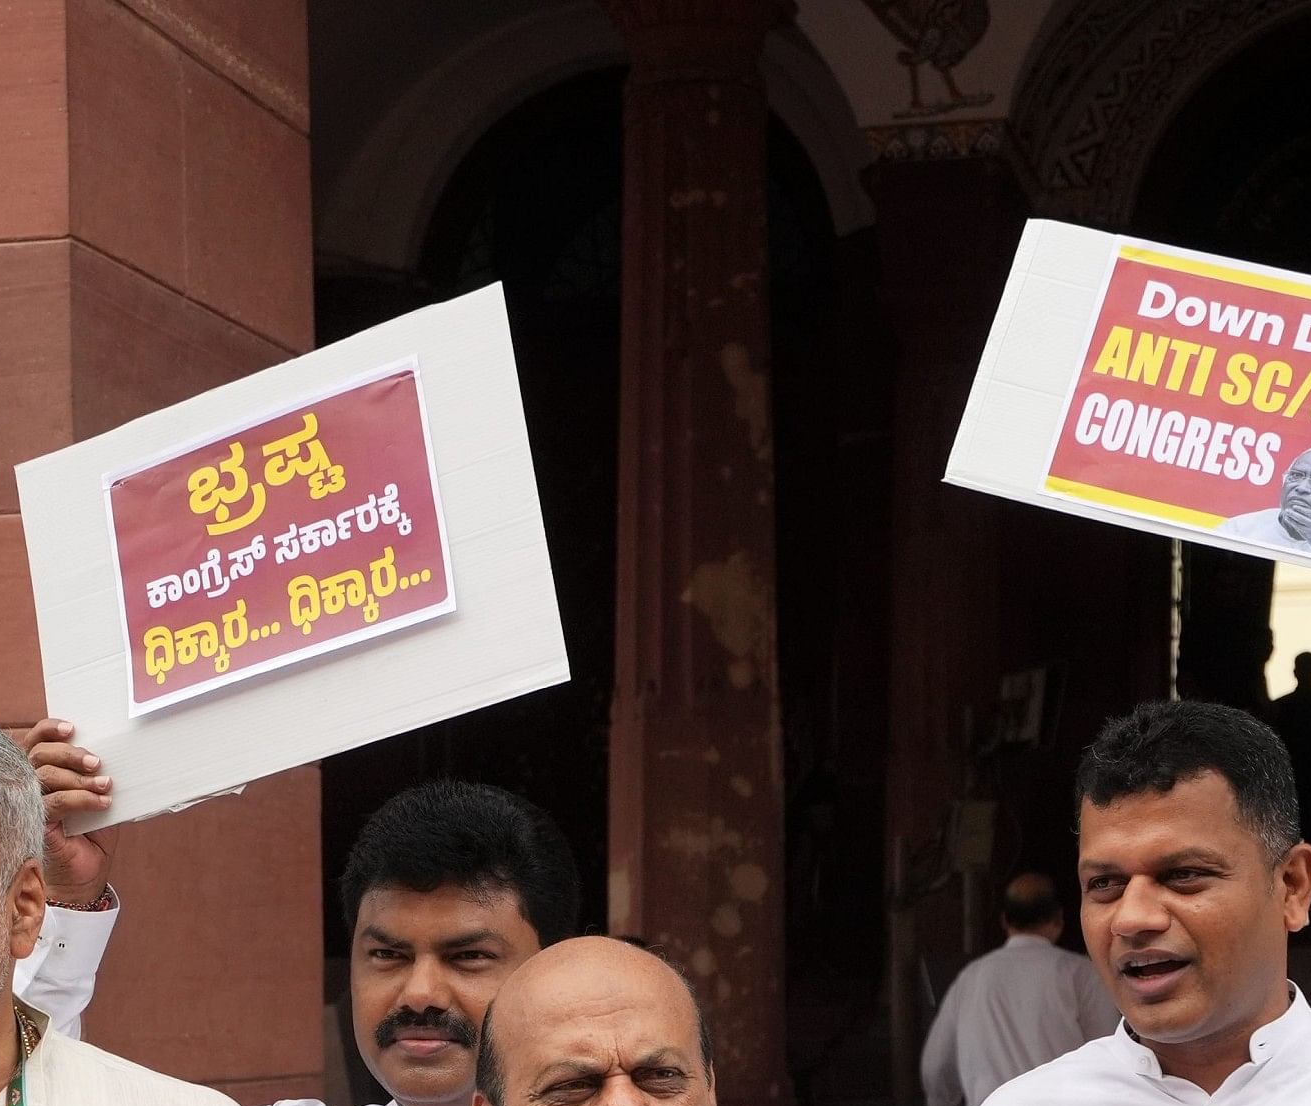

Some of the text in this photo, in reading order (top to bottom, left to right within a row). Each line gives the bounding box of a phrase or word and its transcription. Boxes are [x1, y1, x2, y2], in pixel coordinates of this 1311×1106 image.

[1092, 325, 1218, 397] ANTI
[1136, 279, 1286, 345] Down
[187, 413, 346, 536] ಭ್ರಷ್ಟ
[1073, 392, 1282, 487] CONGRESS
[146, 482, 412, 609] ಕಾಂಗ್ರೆಸ್ ಸರ್ಕಾರಕ್ಕೆ
[143, 545, 432, 685] ಧಿಕ್ಕಾರ... ಧಿಕ್ಕಾರ...
